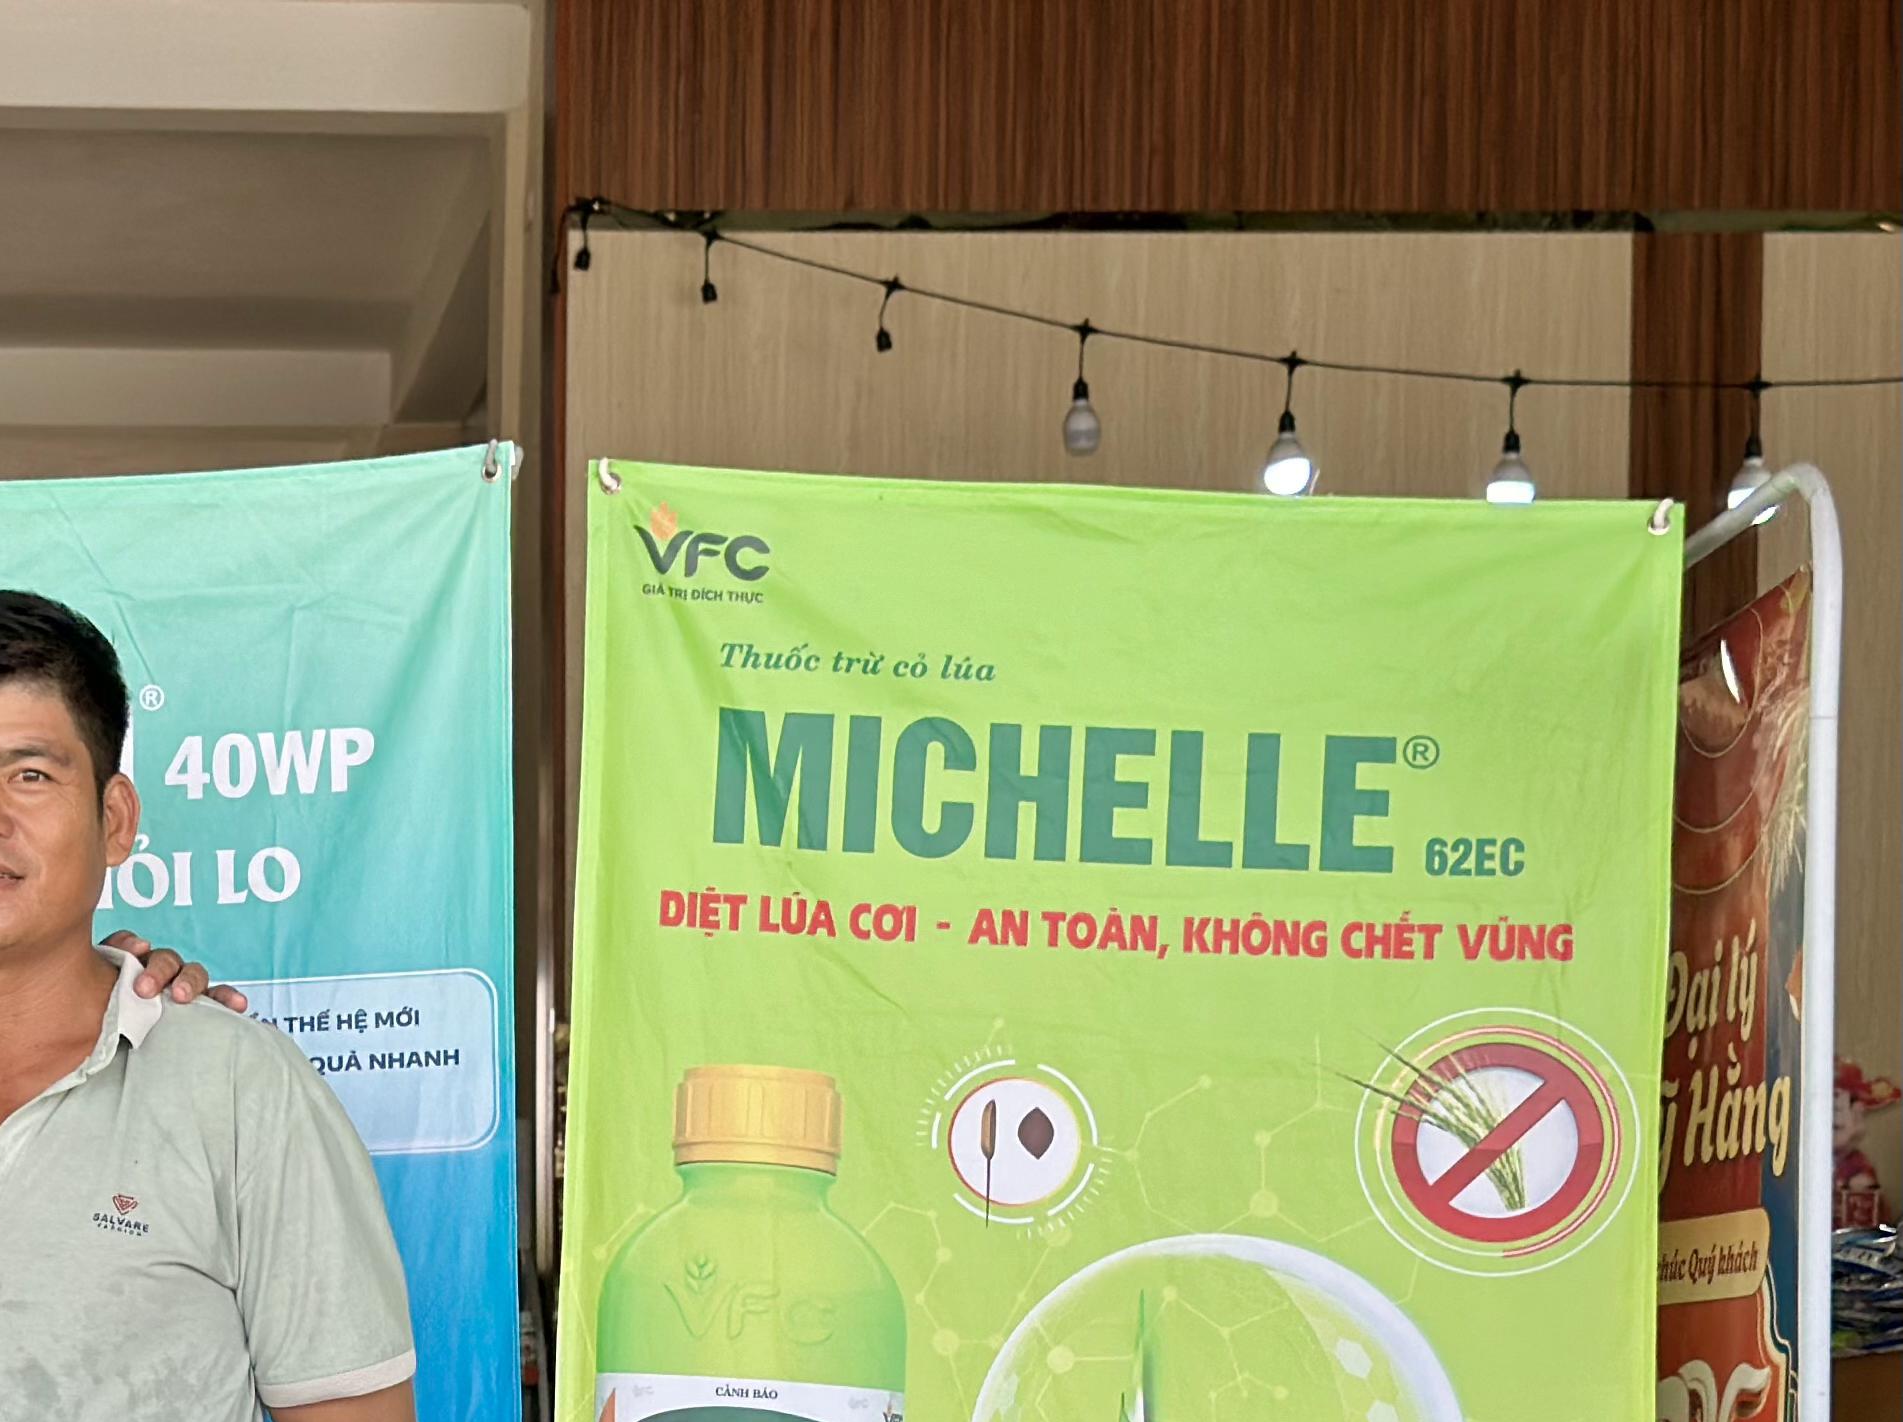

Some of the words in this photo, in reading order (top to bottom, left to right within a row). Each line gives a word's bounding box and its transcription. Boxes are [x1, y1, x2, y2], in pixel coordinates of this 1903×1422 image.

[633, 524, 771, 582] VFC
[720, 642, 821, 672] Thuốc
[831, 650, 886, 675] trừ
[892, 652, 928, 679] cỏ
[941, 654, 997, 682] lúa
[164, 727, 375, 800] 40WP
[96, 833, 193, 910] ỎI
[216, 847, 302, 906] LO
[1424, 837, 1526, 877] 62EC
[659, 886, 748, 937] DIỆT
[967, 907, 1029, 947] AN
[1183, 912, 1328, 960] KHÔNG
[1340, 911, 1443, 961] CHẾT
[284, 1009, 330, 1033] THẾ
[336, 1009, 368, 1034] HỆ
[374, 1006, 420, 1029] MỚI
[369, 1048, 461, 1072] NHANH
[1658, 1248, 1686, 1282] húc
[664, 1282, 837, 1347] VFC
[715, 1384, 750, 1399] CẢNH
[753, 1386, 779, 1400] BÁO
